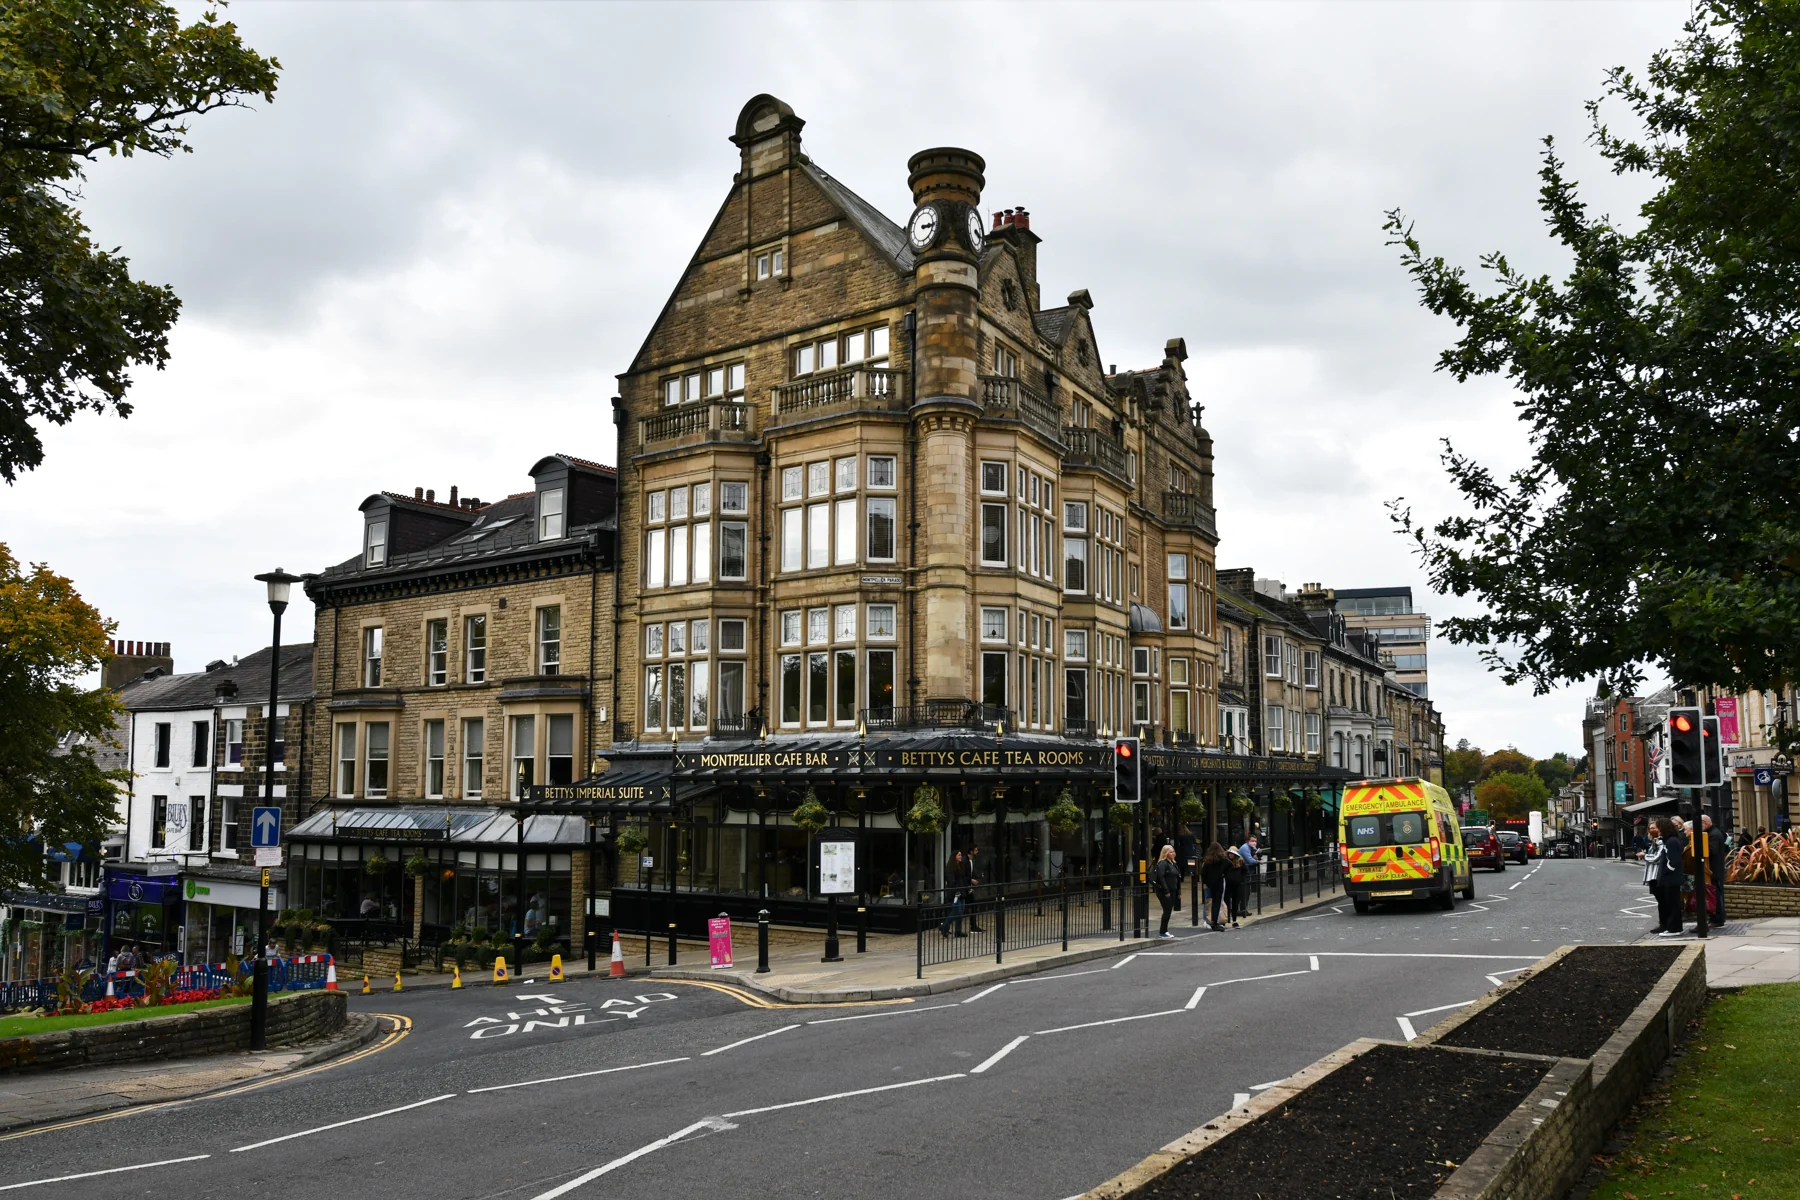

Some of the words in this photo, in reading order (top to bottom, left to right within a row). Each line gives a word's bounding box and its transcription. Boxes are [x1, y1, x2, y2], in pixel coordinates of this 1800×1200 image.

[701, 753, 771, 767] MONTPELLIER
[774, 752, 803, 766] CAFE
[805, 752, 828, 766] BAR
[901, 751, 955, 765] BETTYS
[960, 751, 1000, 765] CAFE
[1004, 751, 1034, 765] TEA
[1038, 751, 1084, 765] ROOMS
[1190, 757, 1198, 768] TEA
[545, 787, 574, 799] BETTYS
[576, 787, 616, 799] IMPERIAL
[618, 786, 644, 799] SUITE
[1345, 802, 1384, 812] EMERGENCY
[1385, 799, 1425, 809] AMBULANCE
[167, 803, 188, 829] BLUES
[356, 828, 374, 837] BETTYS
[375, 829, 388, 837] CAFE
[390, 829, 401, 837] TEA
[403, 830, 422, 838] ROOMS
[1357, 827, 1375, 836] NHS
[264, 869, 270, 877] B
[463, 992, 679, 1028] AHEAD
[469, 1006, 649, 1040] ONLY
